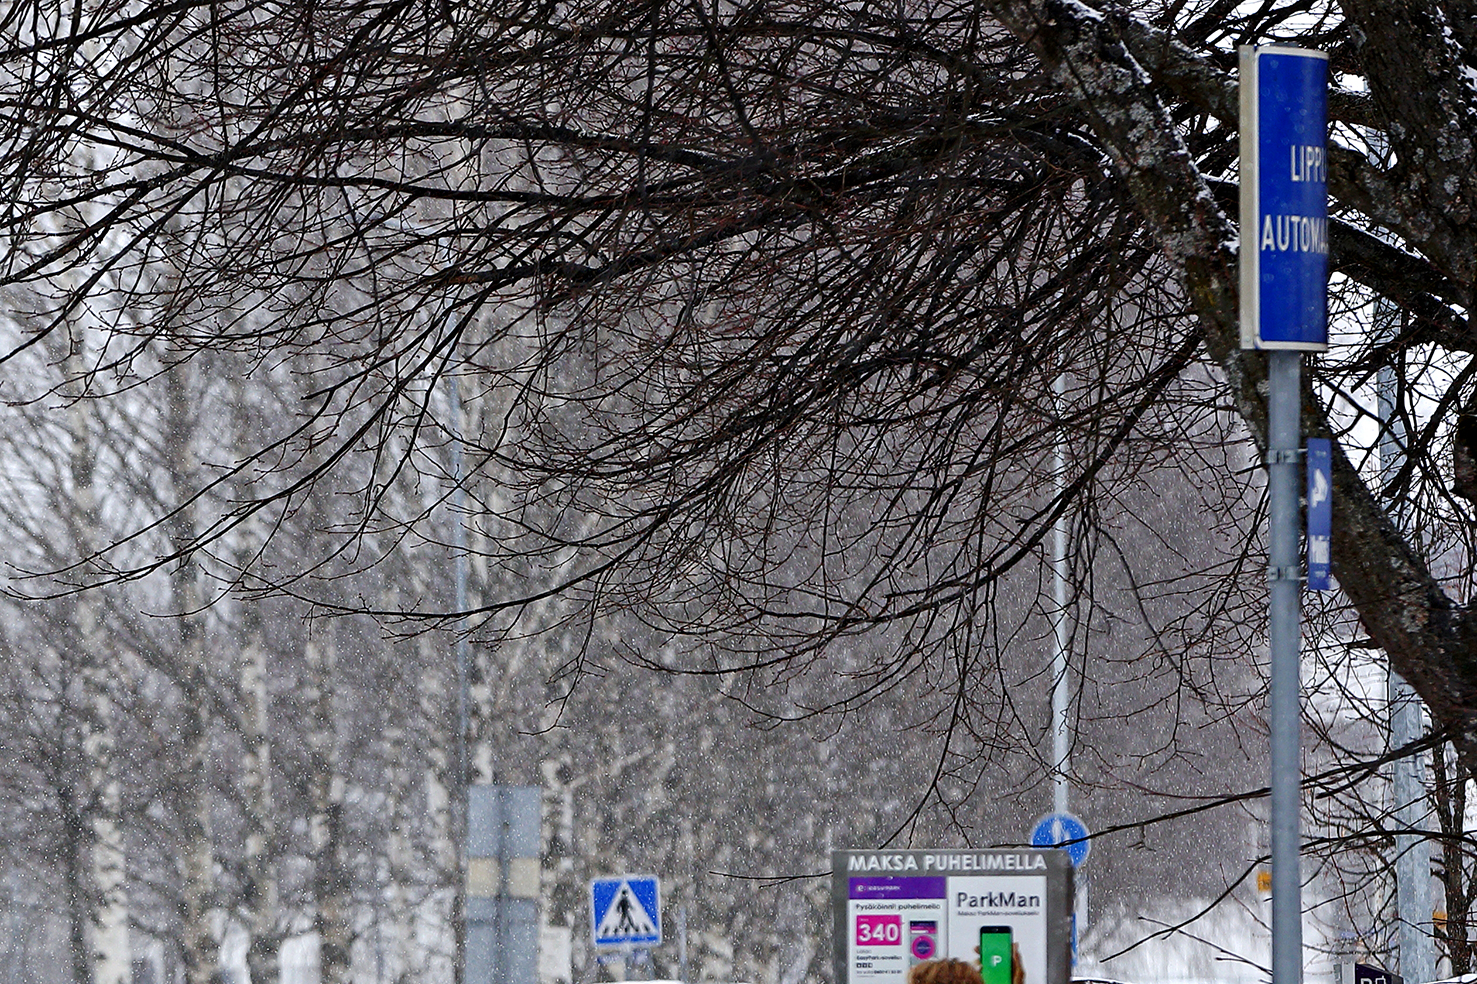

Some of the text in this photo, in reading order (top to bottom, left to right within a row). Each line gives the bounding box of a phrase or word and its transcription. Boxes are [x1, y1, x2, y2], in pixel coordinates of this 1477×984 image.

[847, 854, 1047, 871] MAKSA PUHELIMELLA
[957, 892, 1040, 908] ParkMan
[859, 923, 899, 942] 340
